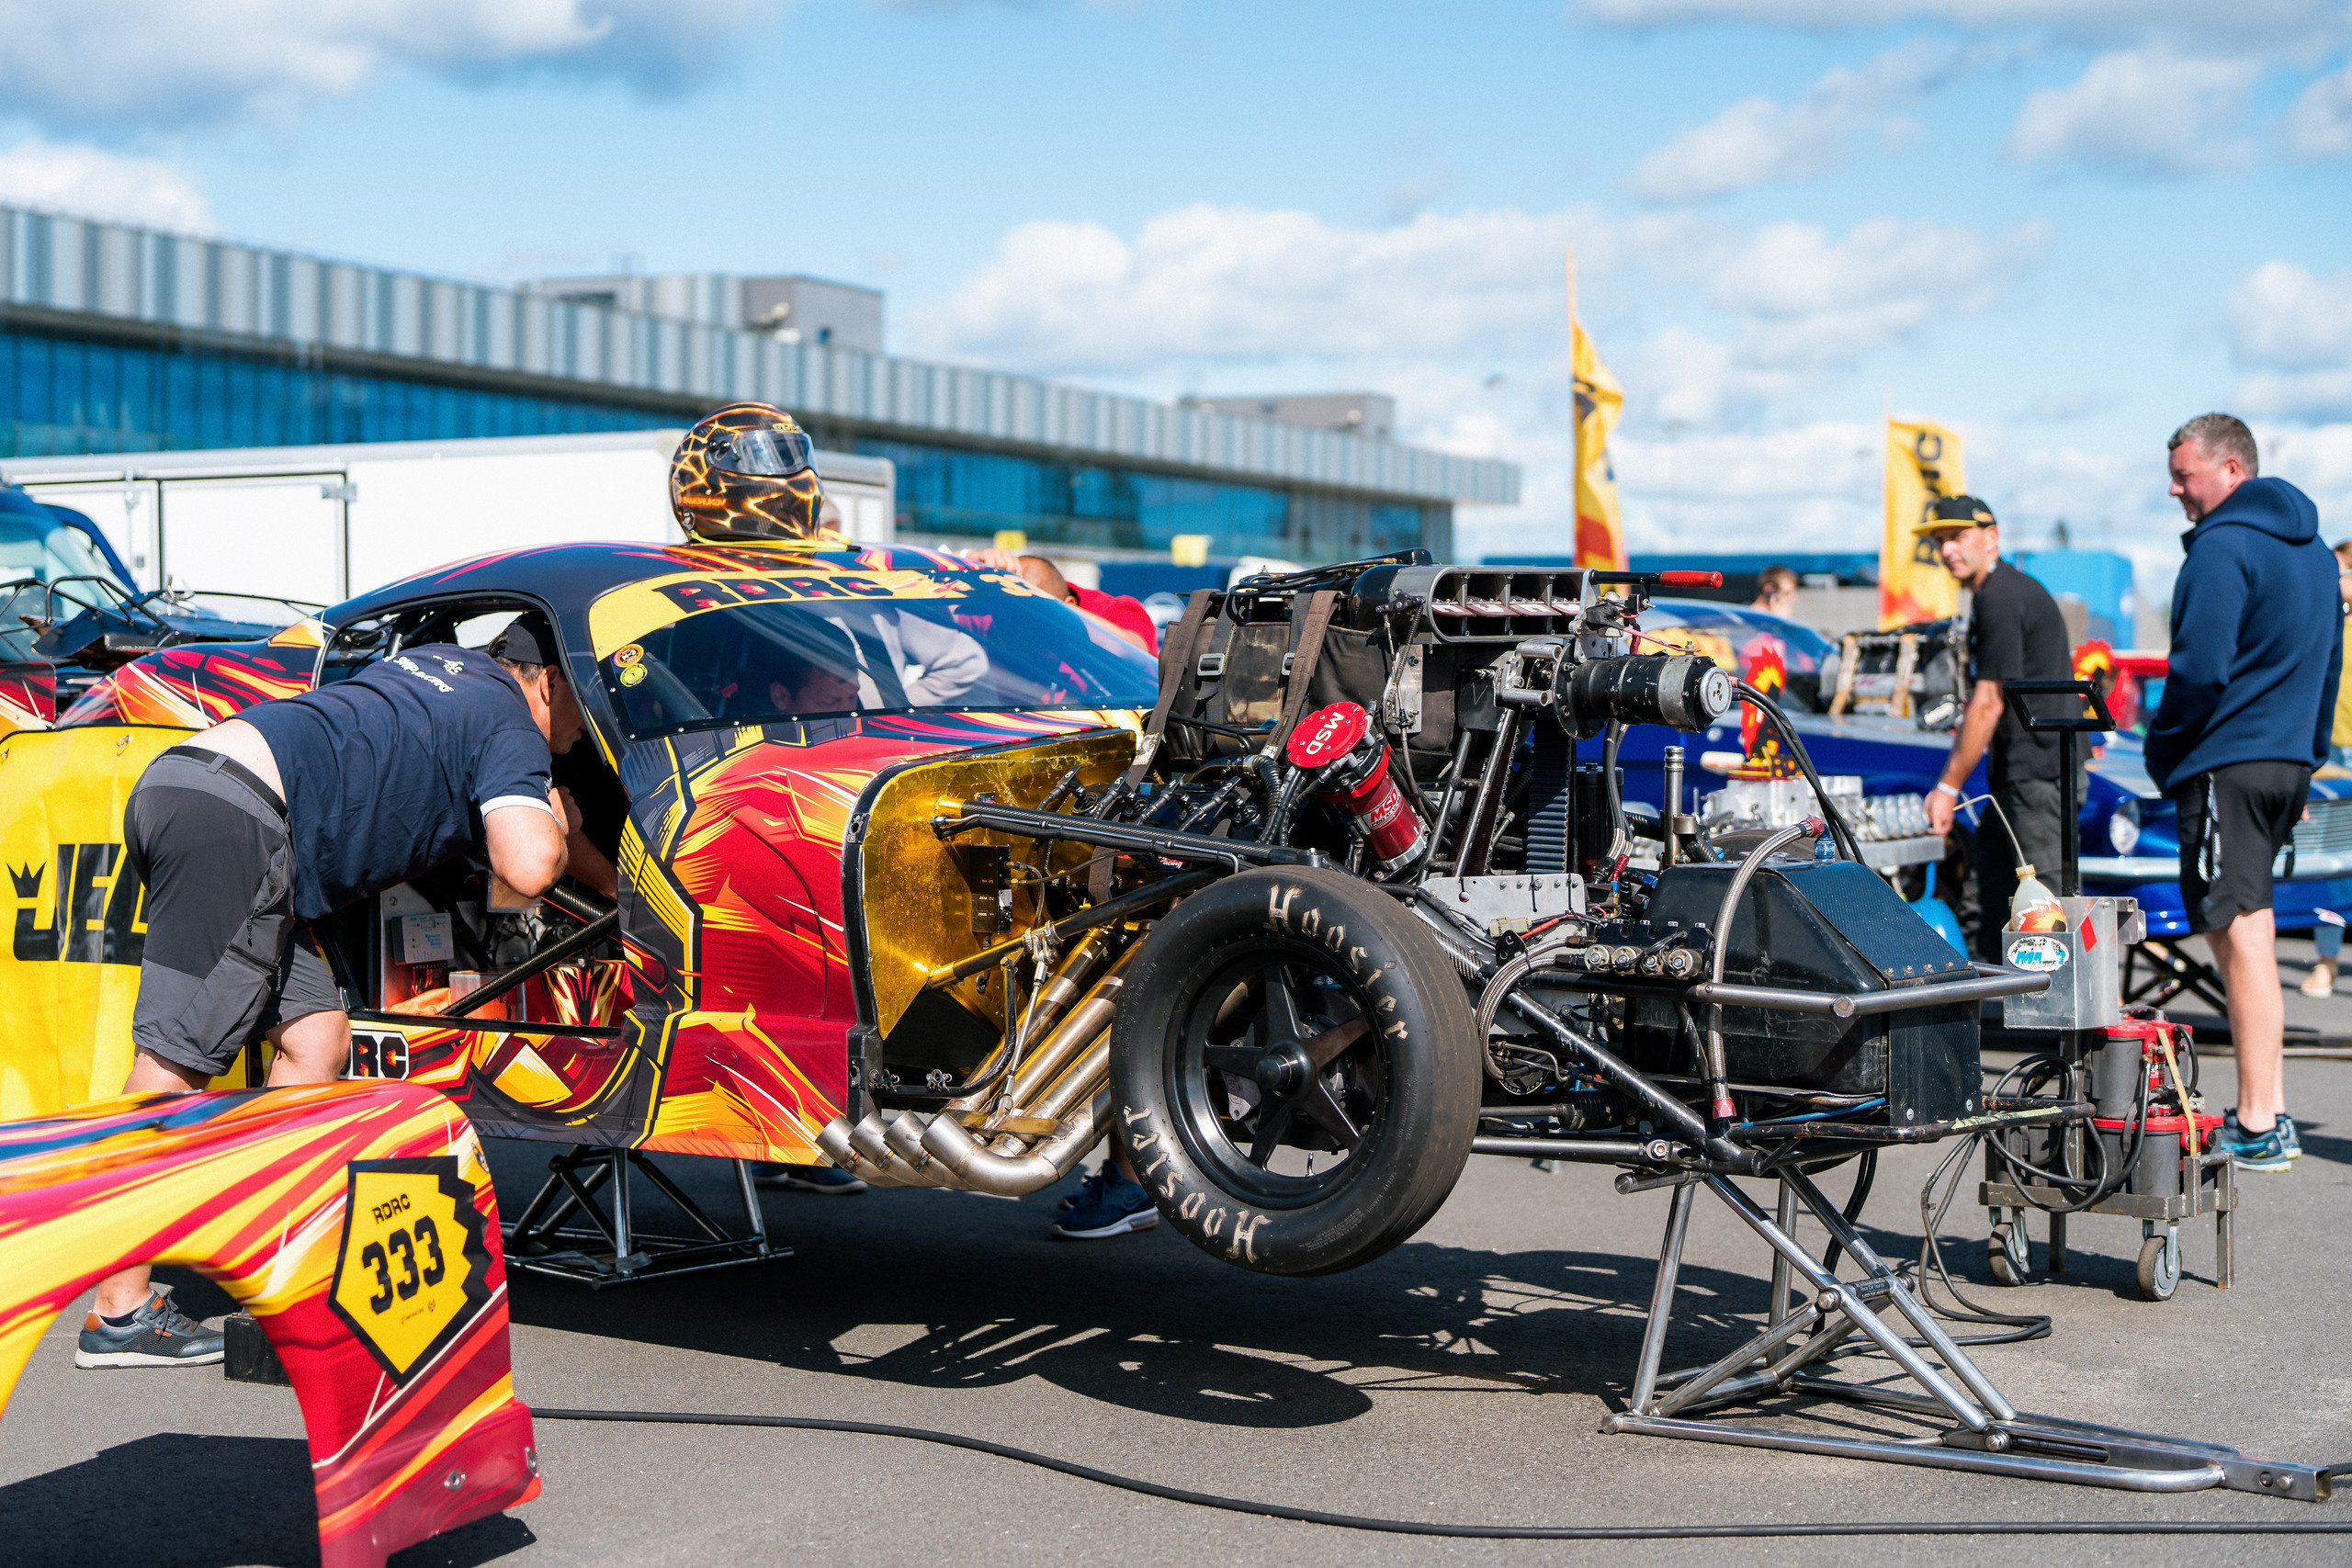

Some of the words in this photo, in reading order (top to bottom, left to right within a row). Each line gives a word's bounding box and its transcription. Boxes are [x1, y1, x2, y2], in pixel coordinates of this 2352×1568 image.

[650, 577, 894, 615] RDRC
[1306, 712, 1345, 755] MSD
[1222, 783, 1233, 791] 2
[1370, 788, 1398, 823] MSD
[1261, 884, 1409, 1040] Hoosier
[341, 1034, 407, 1078] RC
[1123, 1105, 1273, 1264] Hoosier
[372, 1193, 411, 1224] RDRC
[361, 1215, 446, 1315] 333
